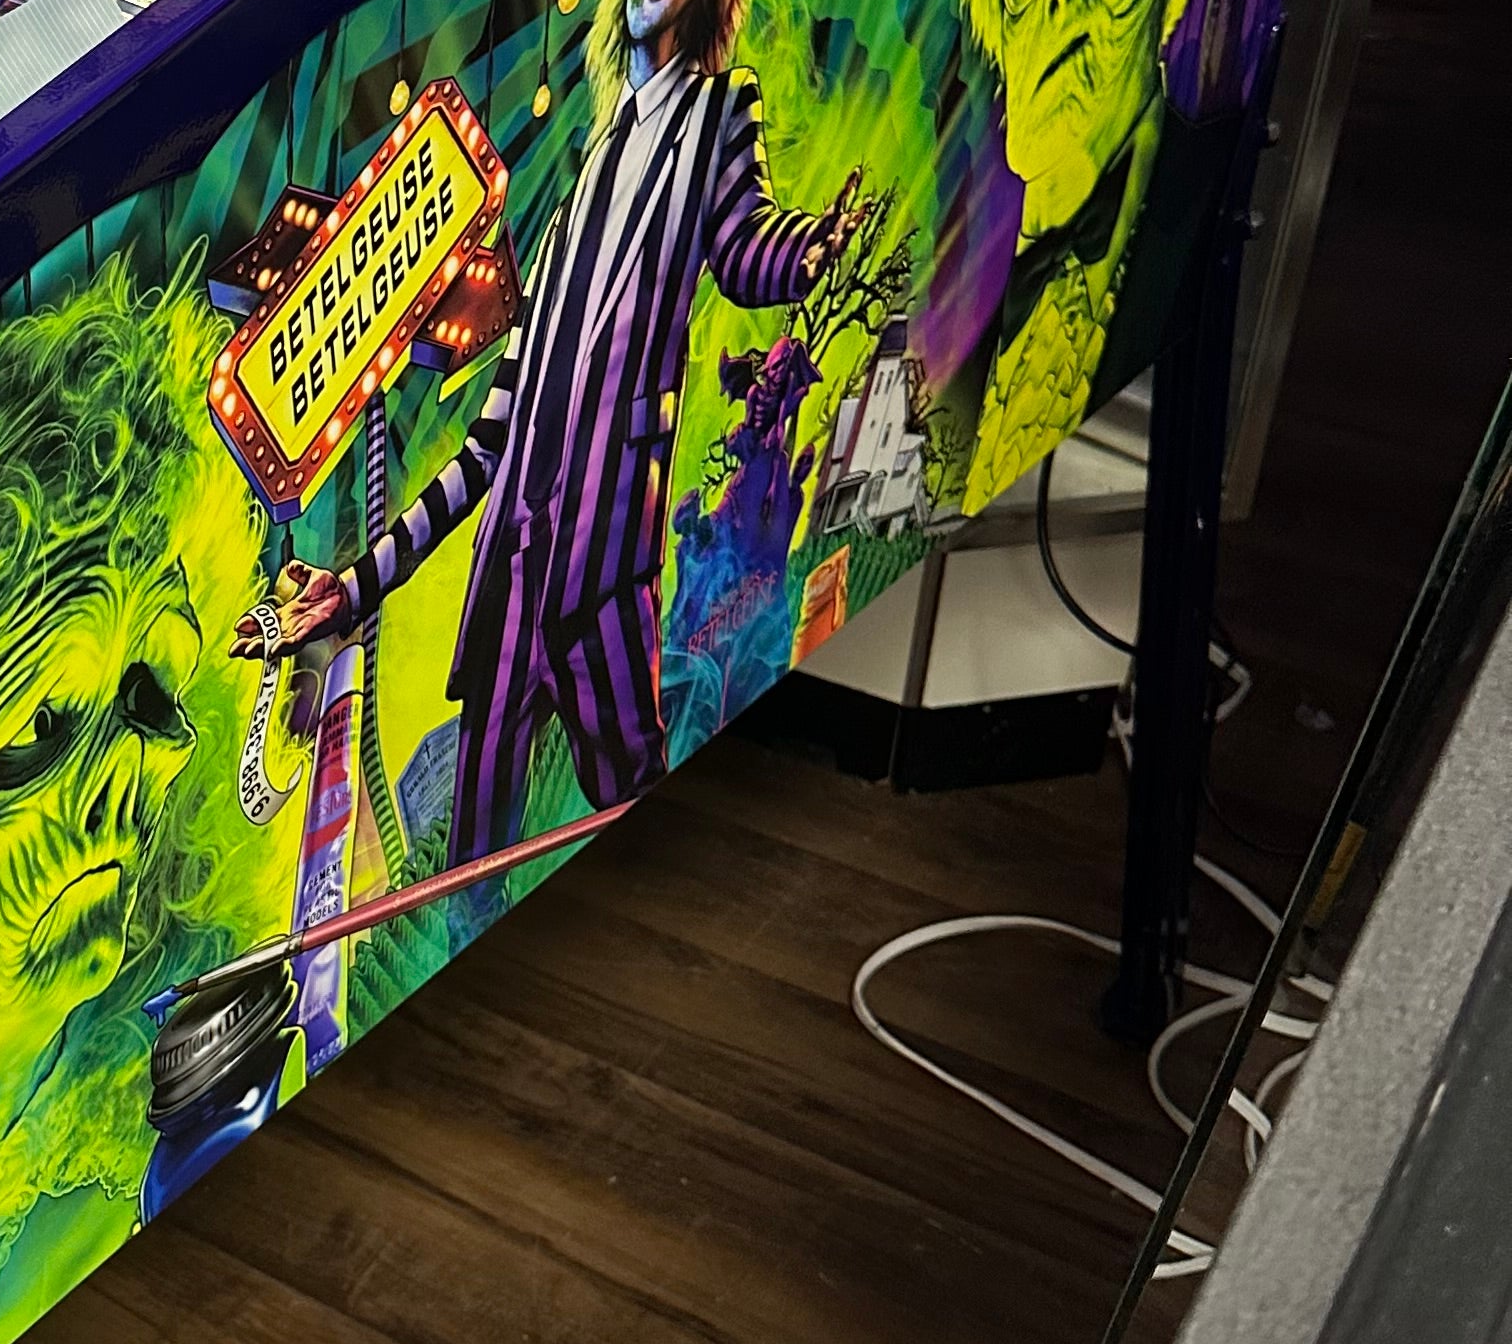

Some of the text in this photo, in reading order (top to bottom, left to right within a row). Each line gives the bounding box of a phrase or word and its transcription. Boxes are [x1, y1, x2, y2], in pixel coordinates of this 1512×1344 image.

[269, 137, 434, 386] BETELGEUSE
[291, 174, 455, 427] BETELGEUSE
[304, 900, 339, 927] MODELS
[308, 859, 343, 892] CEMENT
